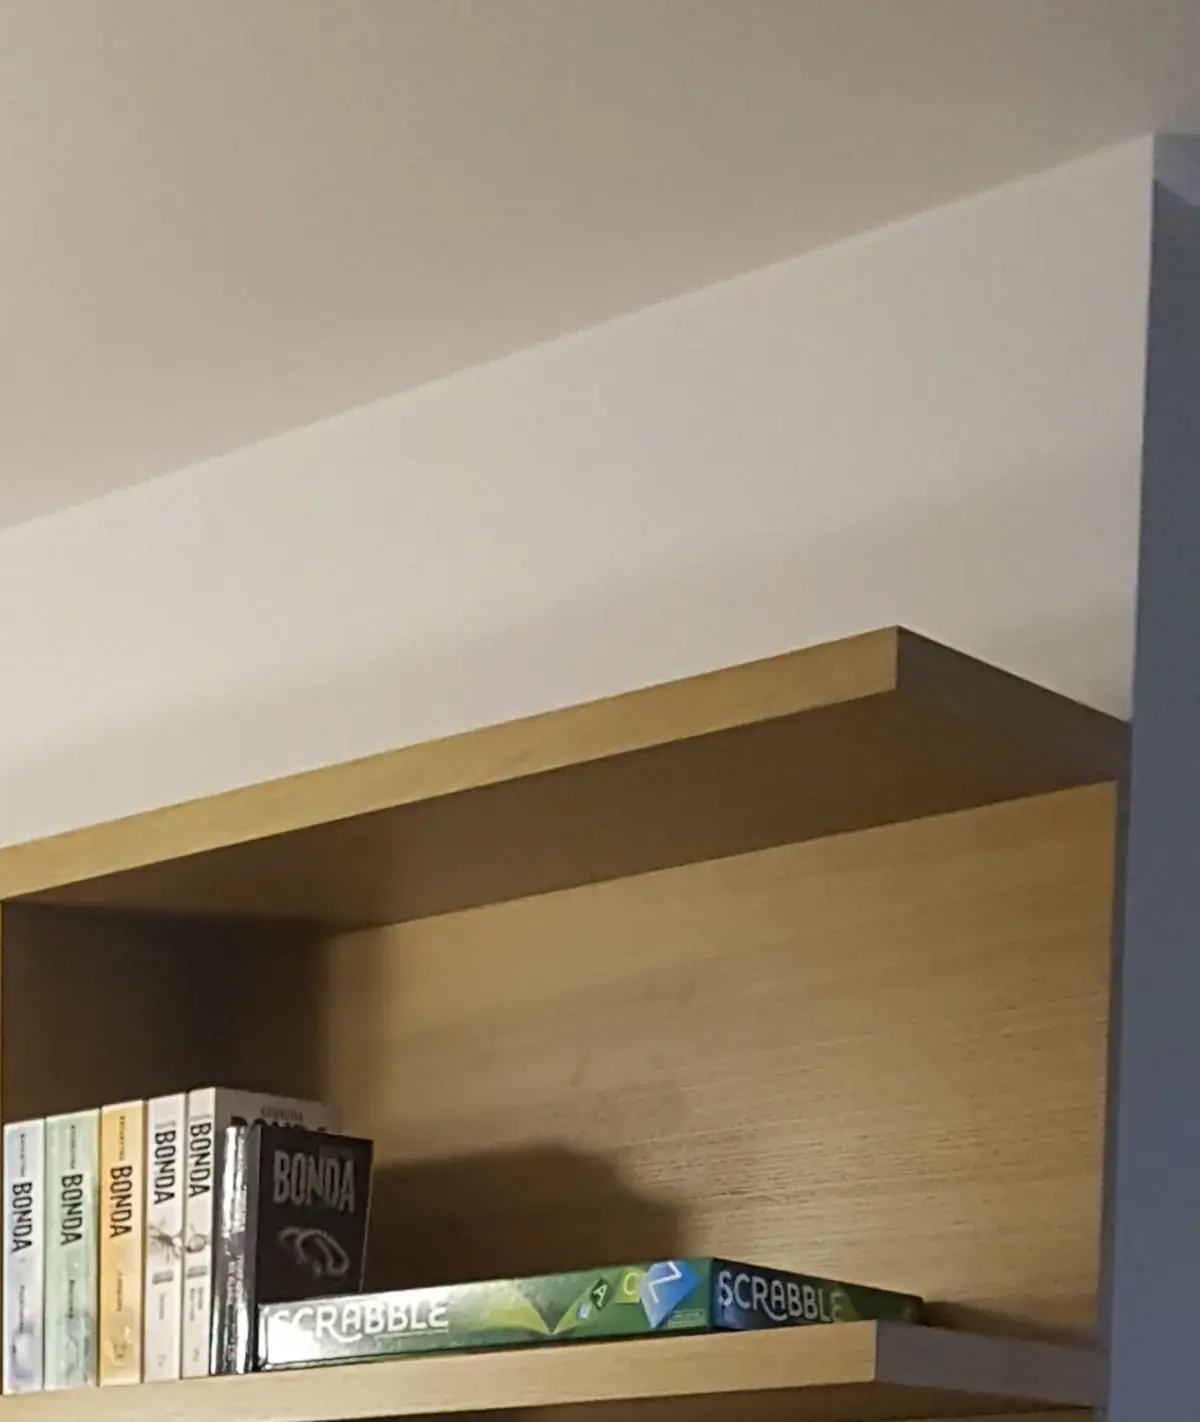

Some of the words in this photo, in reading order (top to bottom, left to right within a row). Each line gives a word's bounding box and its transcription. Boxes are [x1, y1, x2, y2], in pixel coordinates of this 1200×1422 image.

[154, 1130, 177, 1206] BONDA
[188, 1122, 211, 1198] BONDA
[273, 1150, 356, 1213] BONDA
[12, 1182, 33, 1253] BONDA
[61, 1174, 84, 1246] BONDA
[110, 1165, 133, 1239] BONDA
[274, 1298, 450, 1344] SCRABBLE
[717, 1270, 844, 1325] SCRABBLE
